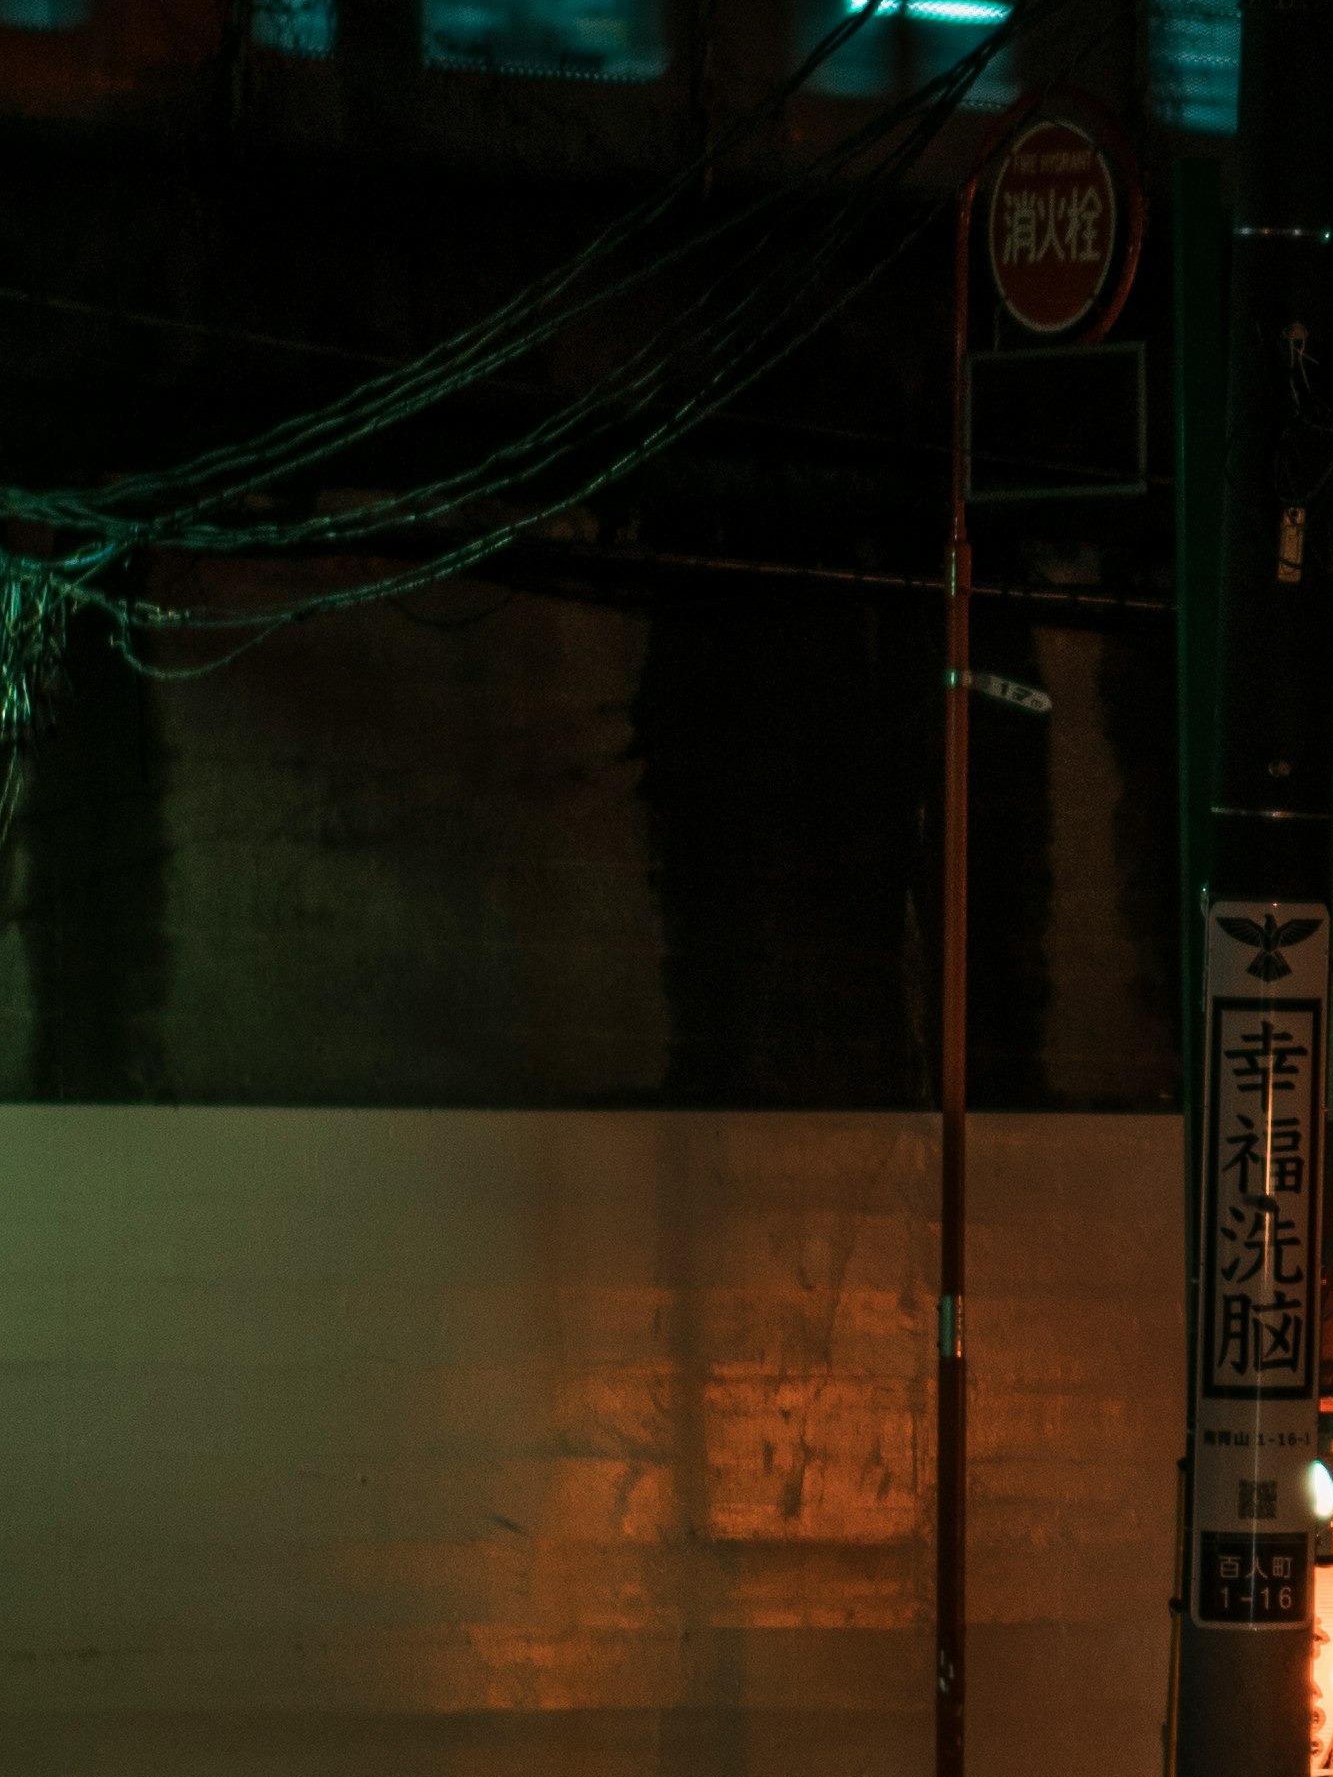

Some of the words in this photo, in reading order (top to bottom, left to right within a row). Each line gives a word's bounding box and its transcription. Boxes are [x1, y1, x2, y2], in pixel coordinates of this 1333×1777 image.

[1002, 186, 1103, 264] 消火栓
[1217, 1555, 1294, 1580] 百人町
[1219, 1586, 1294, 1610] 1-16
